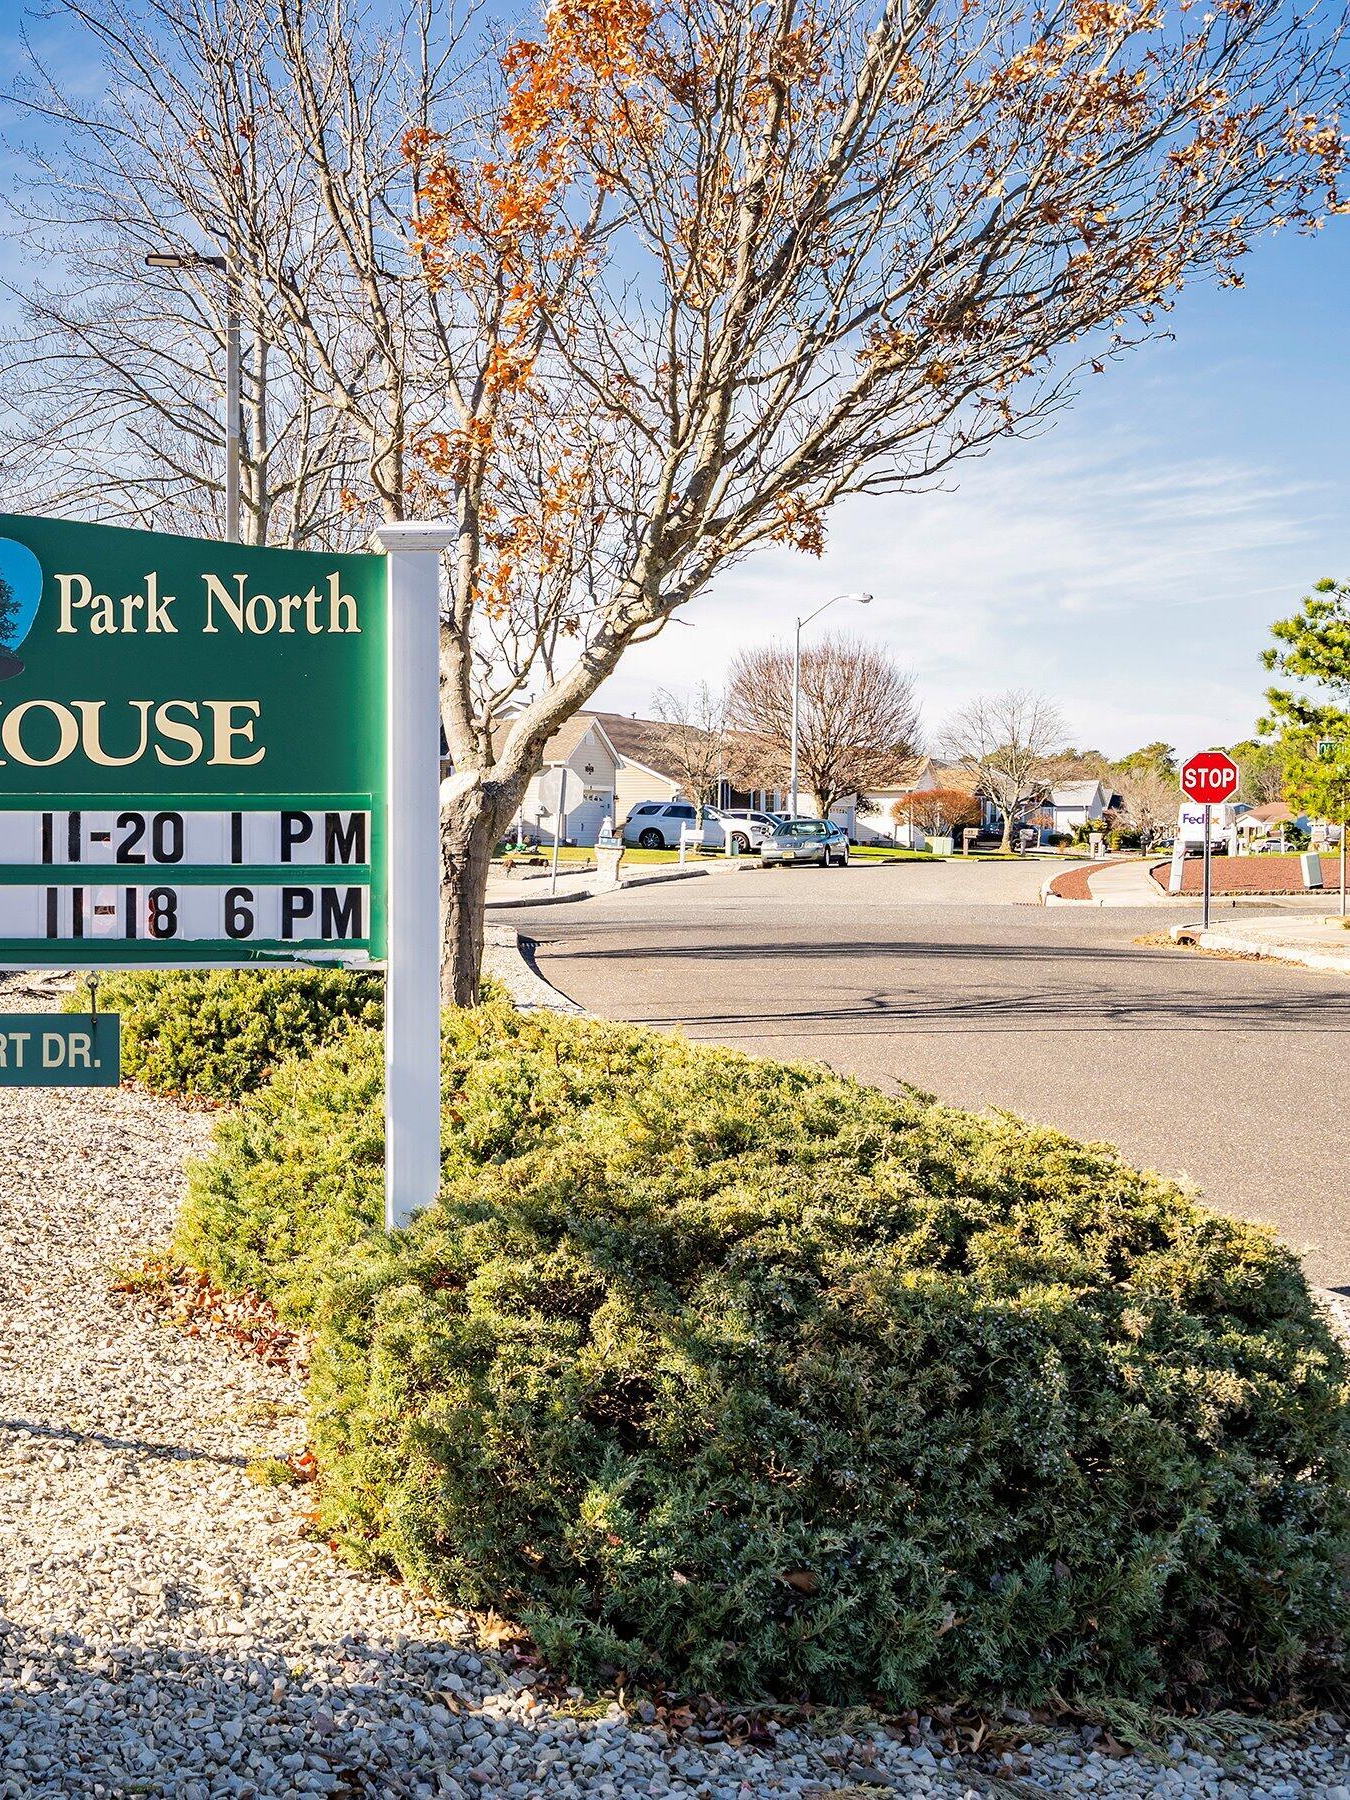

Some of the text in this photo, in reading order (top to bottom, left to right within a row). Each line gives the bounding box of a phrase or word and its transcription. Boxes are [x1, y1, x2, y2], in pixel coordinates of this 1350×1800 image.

[54, 571, 179, 634] Park
[200, 571, 362, 634] North
[1184, 768, 1234, 788] STOP
[42, 811, 184, 864] 11-20
[231, 812, 243, 864] 1
[1182, 813, 1220, 825] Fedx
[46, 887, 178, 939] 11-18
[224, 887, 254, 939] 6
[282, 887, 362, 939] PM
[42, 1033, 101, 1068] DR.
